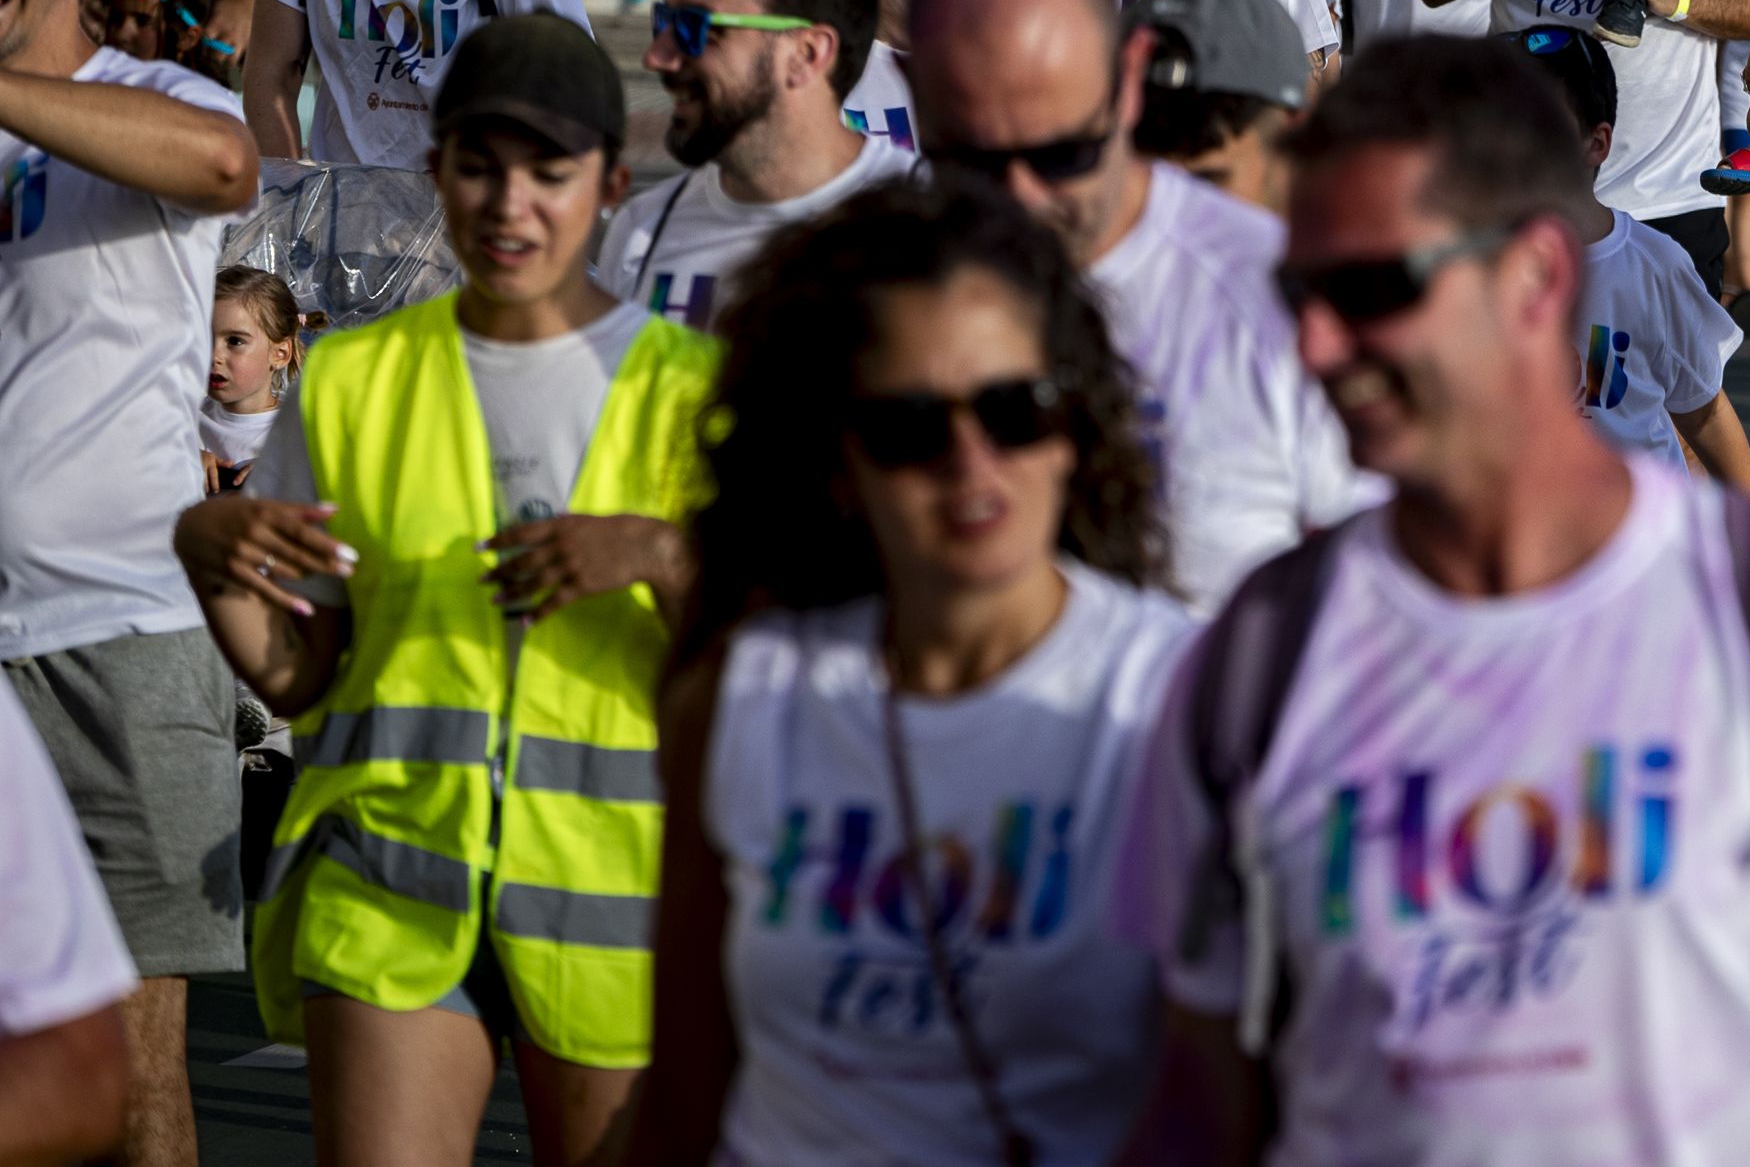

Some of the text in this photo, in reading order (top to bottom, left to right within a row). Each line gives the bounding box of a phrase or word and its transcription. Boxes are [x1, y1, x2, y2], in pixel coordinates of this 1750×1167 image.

[374, 45, 427, 84] Fet
[764, 807, 1074, 946] Holi
[1320, 742, 1680, 938] Holi
